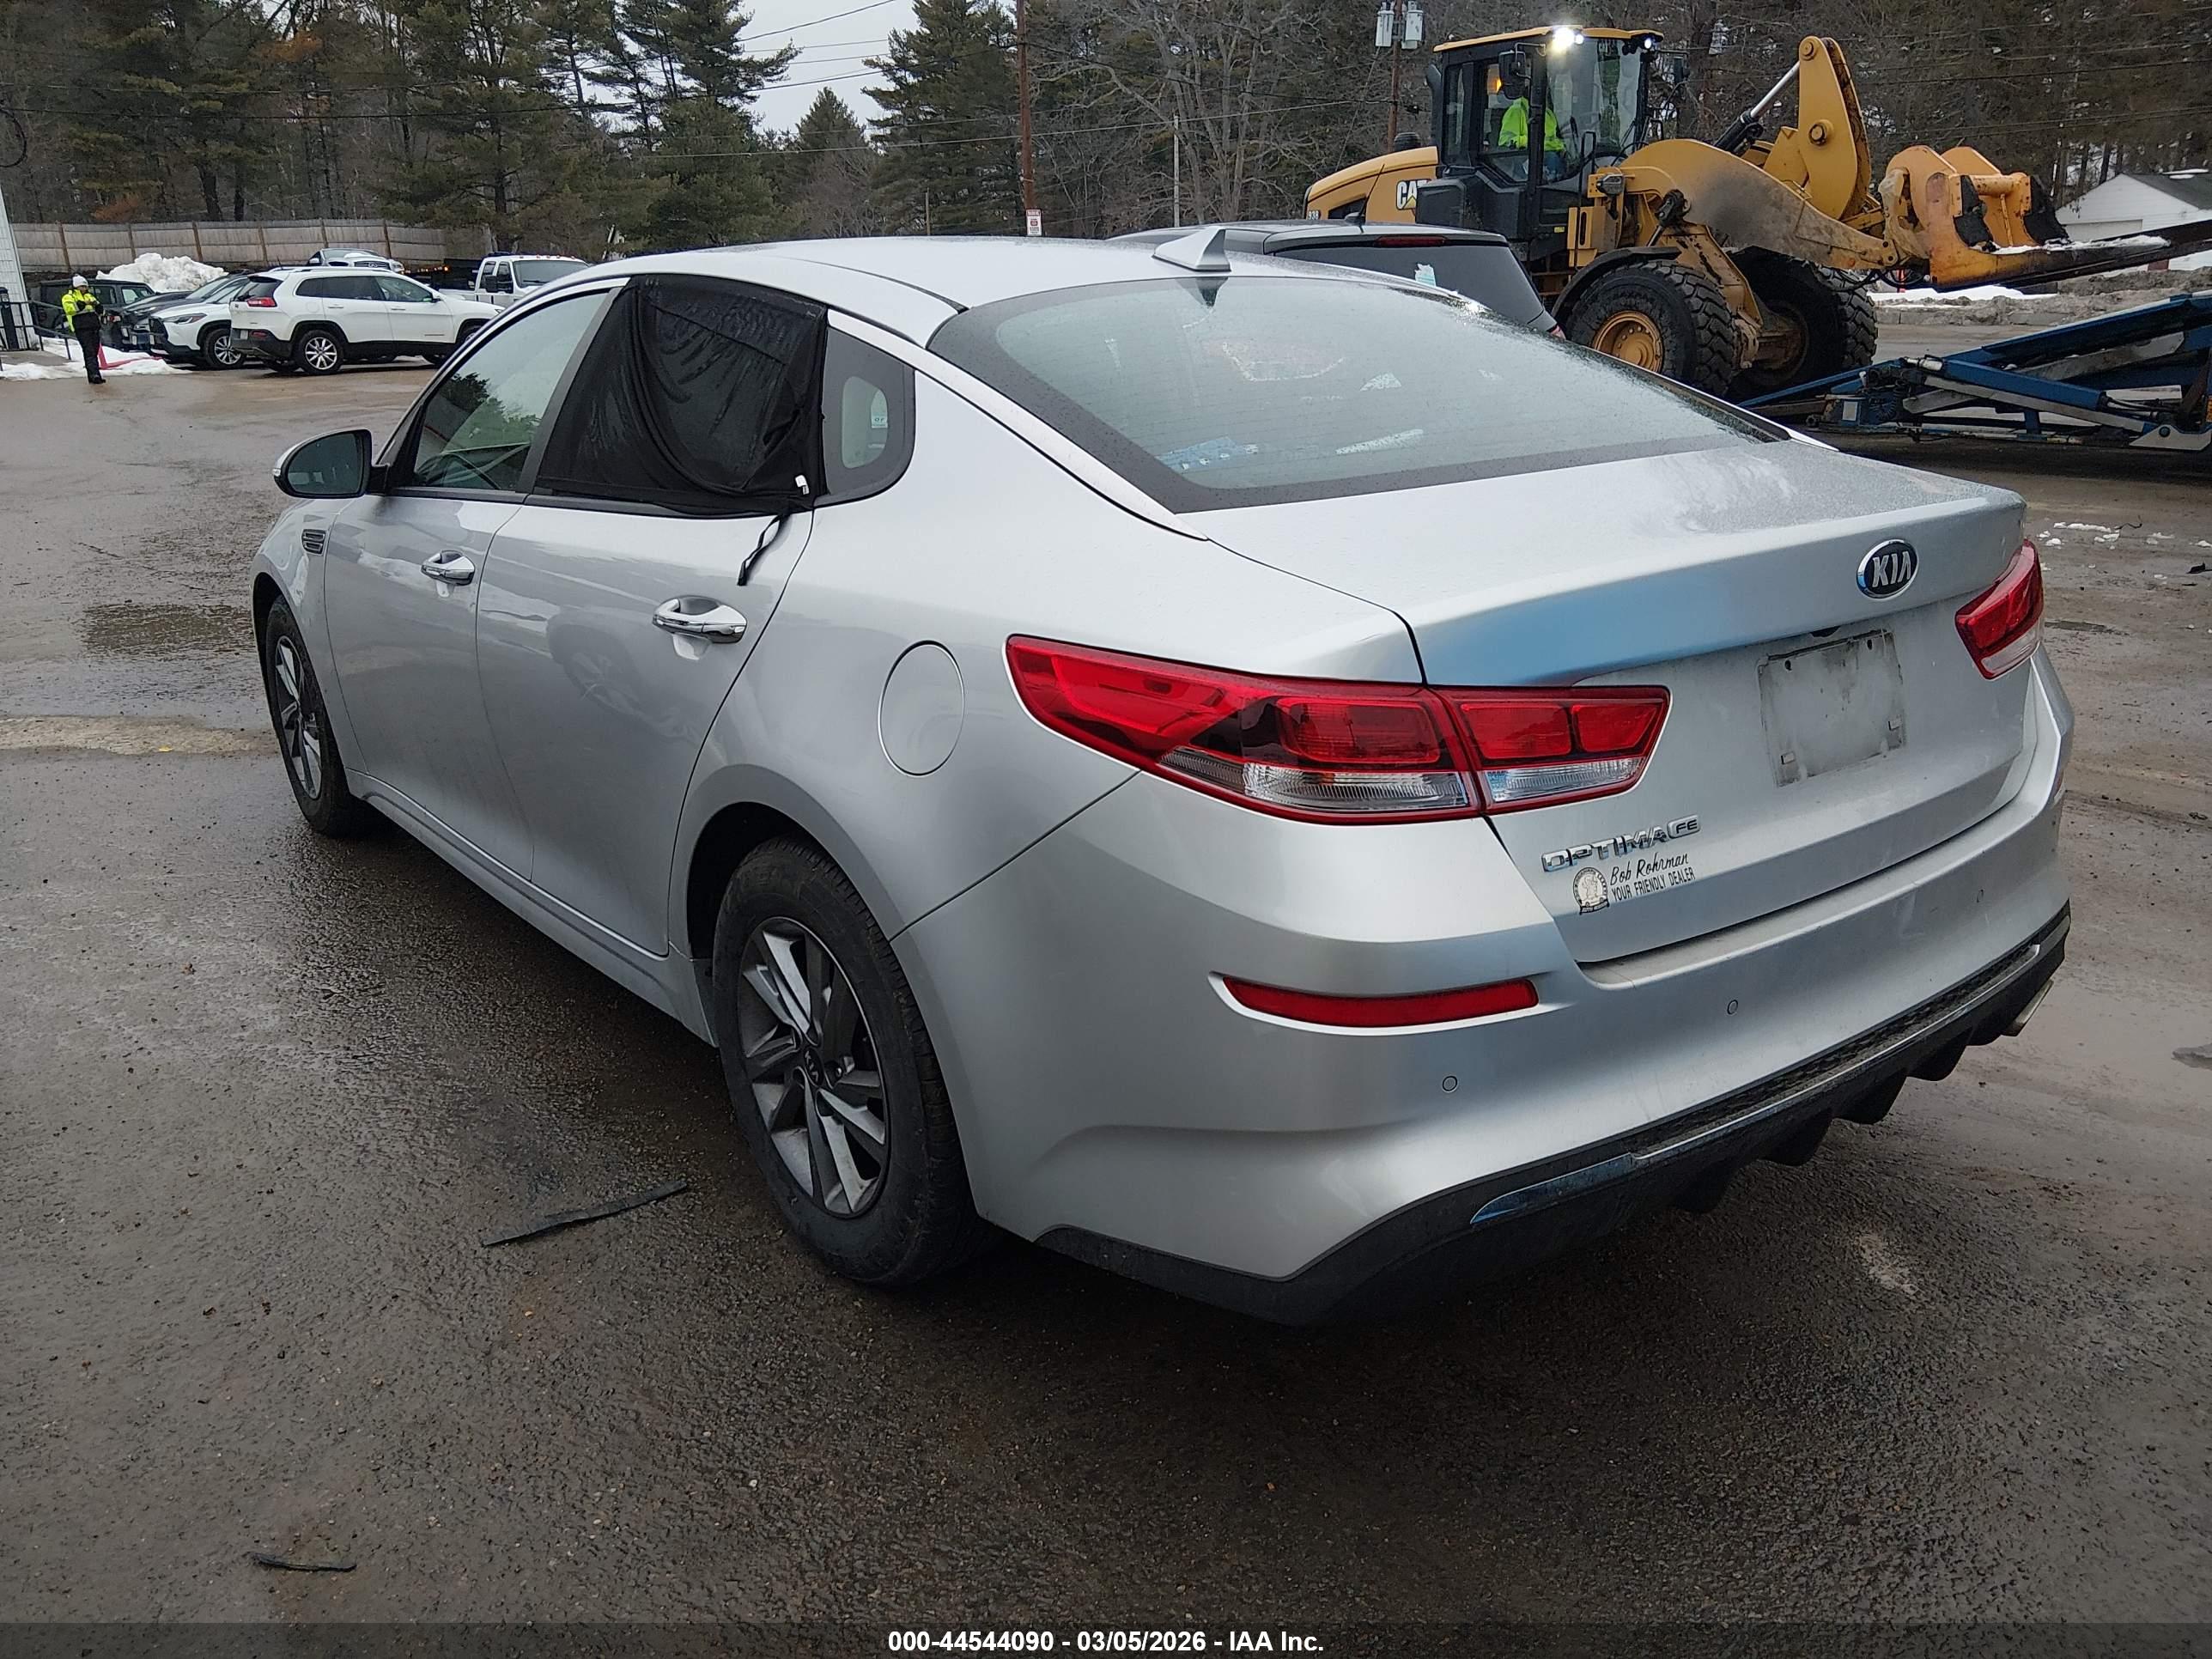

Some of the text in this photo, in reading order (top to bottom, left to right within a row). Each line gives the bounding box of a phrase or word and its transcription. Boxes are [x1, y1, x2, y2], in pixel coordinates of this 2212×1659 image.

[1308, 210, 1320, 221] 938
[1871, 550, 1912, 588] KIA
[1541, 824, 1668, 872] OPTIMA
[1609, 851, 1689, 886] Bob Rohrman
[1611, 884, 1633, 902] YOUR
[1633, 873, 1667, 896] FRIENDLY
[1668, 866, 1697, 886] DEALER
[804, 1050, 819, 1083] KIA
